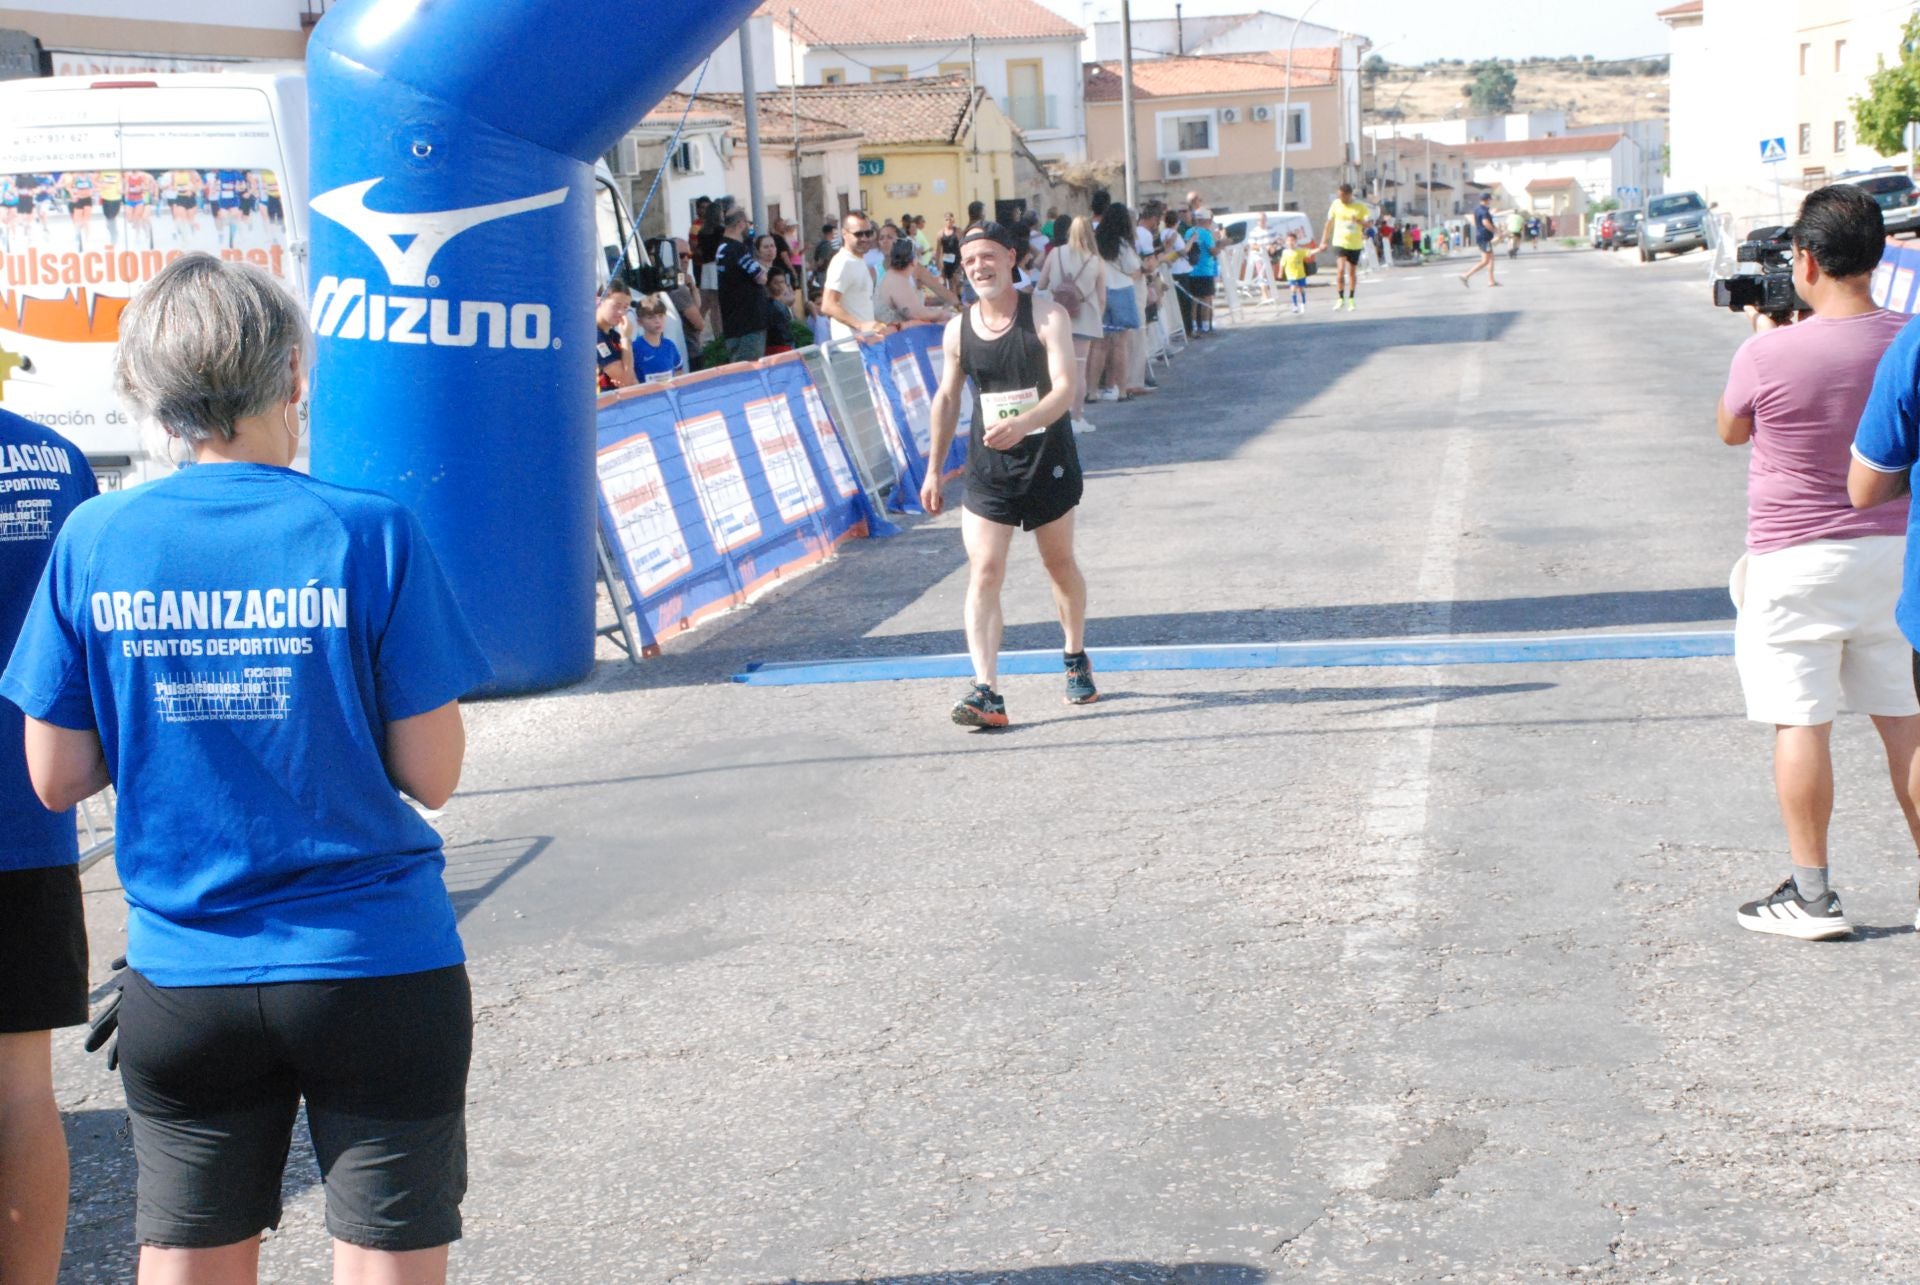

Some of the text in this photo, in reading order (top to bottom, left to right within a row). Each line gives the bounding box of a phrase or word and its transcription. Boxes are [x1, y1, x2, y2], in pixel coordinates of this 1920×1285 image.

[0, 478, 61, 493] EPORTIVOS
[91, 579, 348, 633] ORGANIZACIÓN
[123, 637, 313, 657] EVENTOS DEPORTIVOS
[155, 680, 269, 695] Pulsaciones.net
